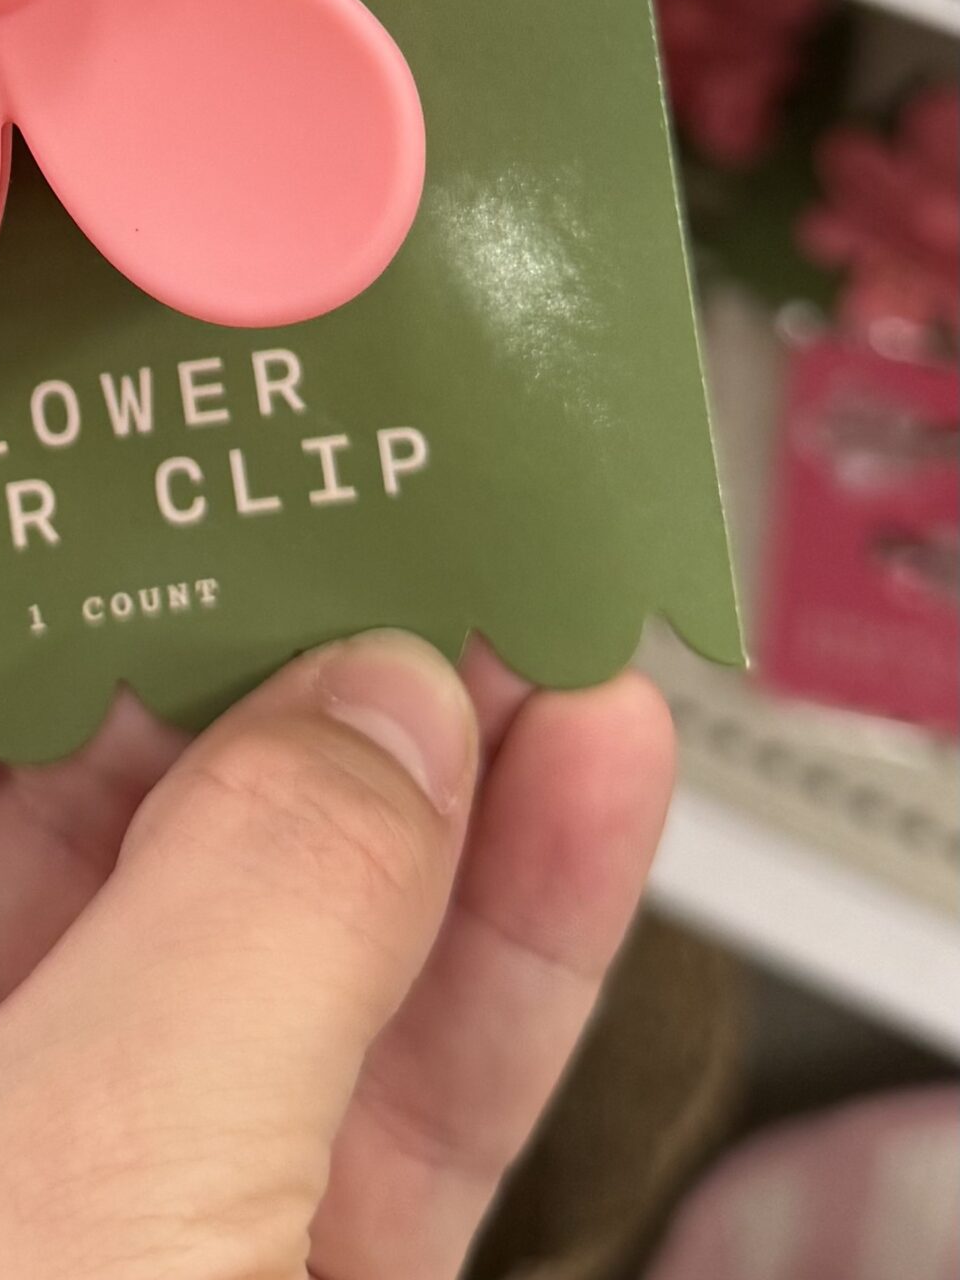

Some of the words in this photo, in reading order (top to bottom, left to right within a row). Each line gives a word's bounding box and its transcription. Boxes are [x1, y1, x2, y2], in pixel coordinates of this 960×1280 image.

[154, 426, 428, 525] CLIP
[27, 603, 47, 633] 1
[80, 578, 220, 623] COUNT
